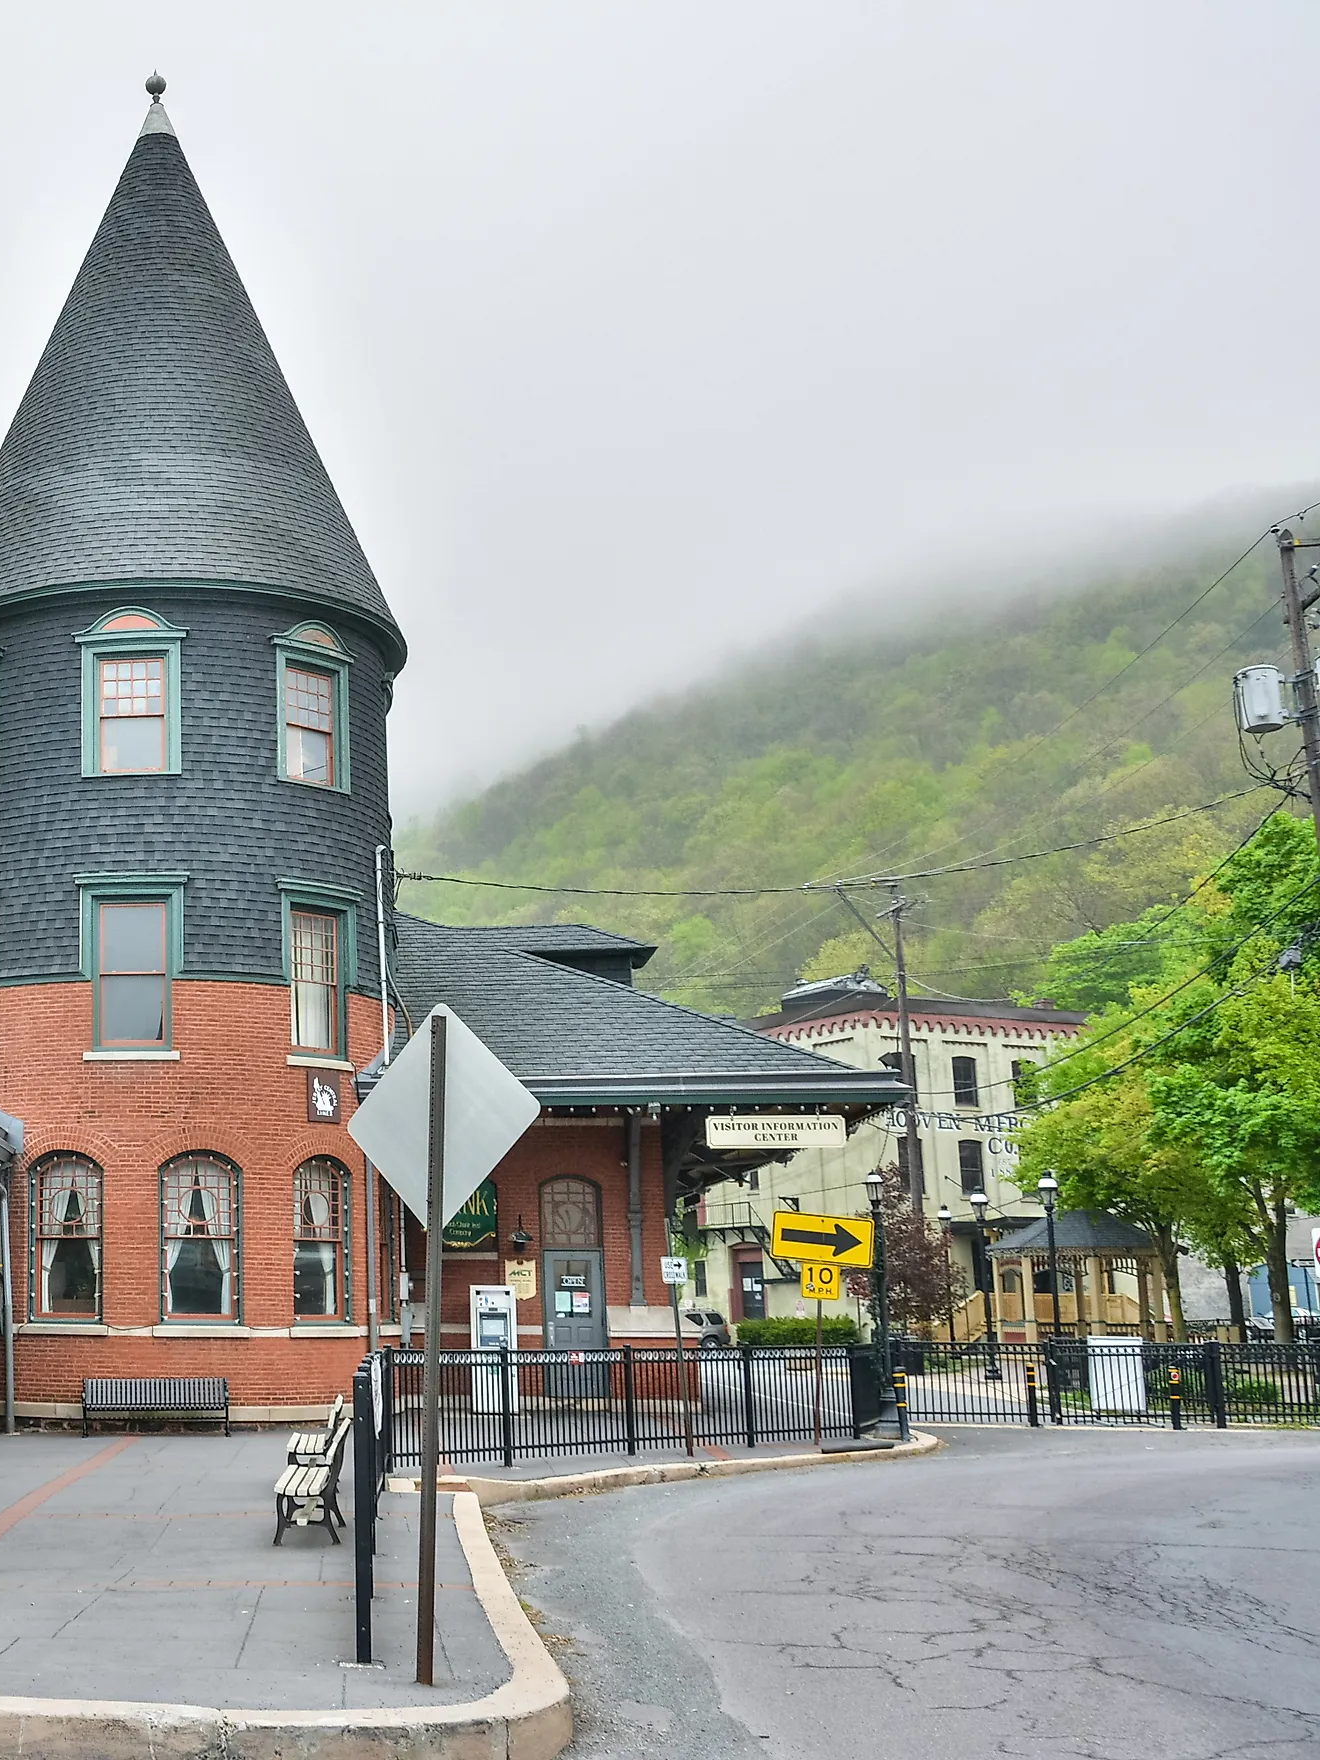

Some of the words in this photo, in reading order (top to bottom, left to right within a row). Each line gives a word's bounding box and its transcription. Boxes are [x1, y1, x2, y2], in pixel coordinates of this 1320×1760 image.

[712, 1122, 759, 1131] VISITOR
[761, 1122, 840, 1131] INFORMATION
[754, 1133, 799, 1142] CENTER
[509, 1269, 533, 1277] MCT
[807, 1267, 834, 1285] 10
[562, 1277, 585, 1286] OPEN
